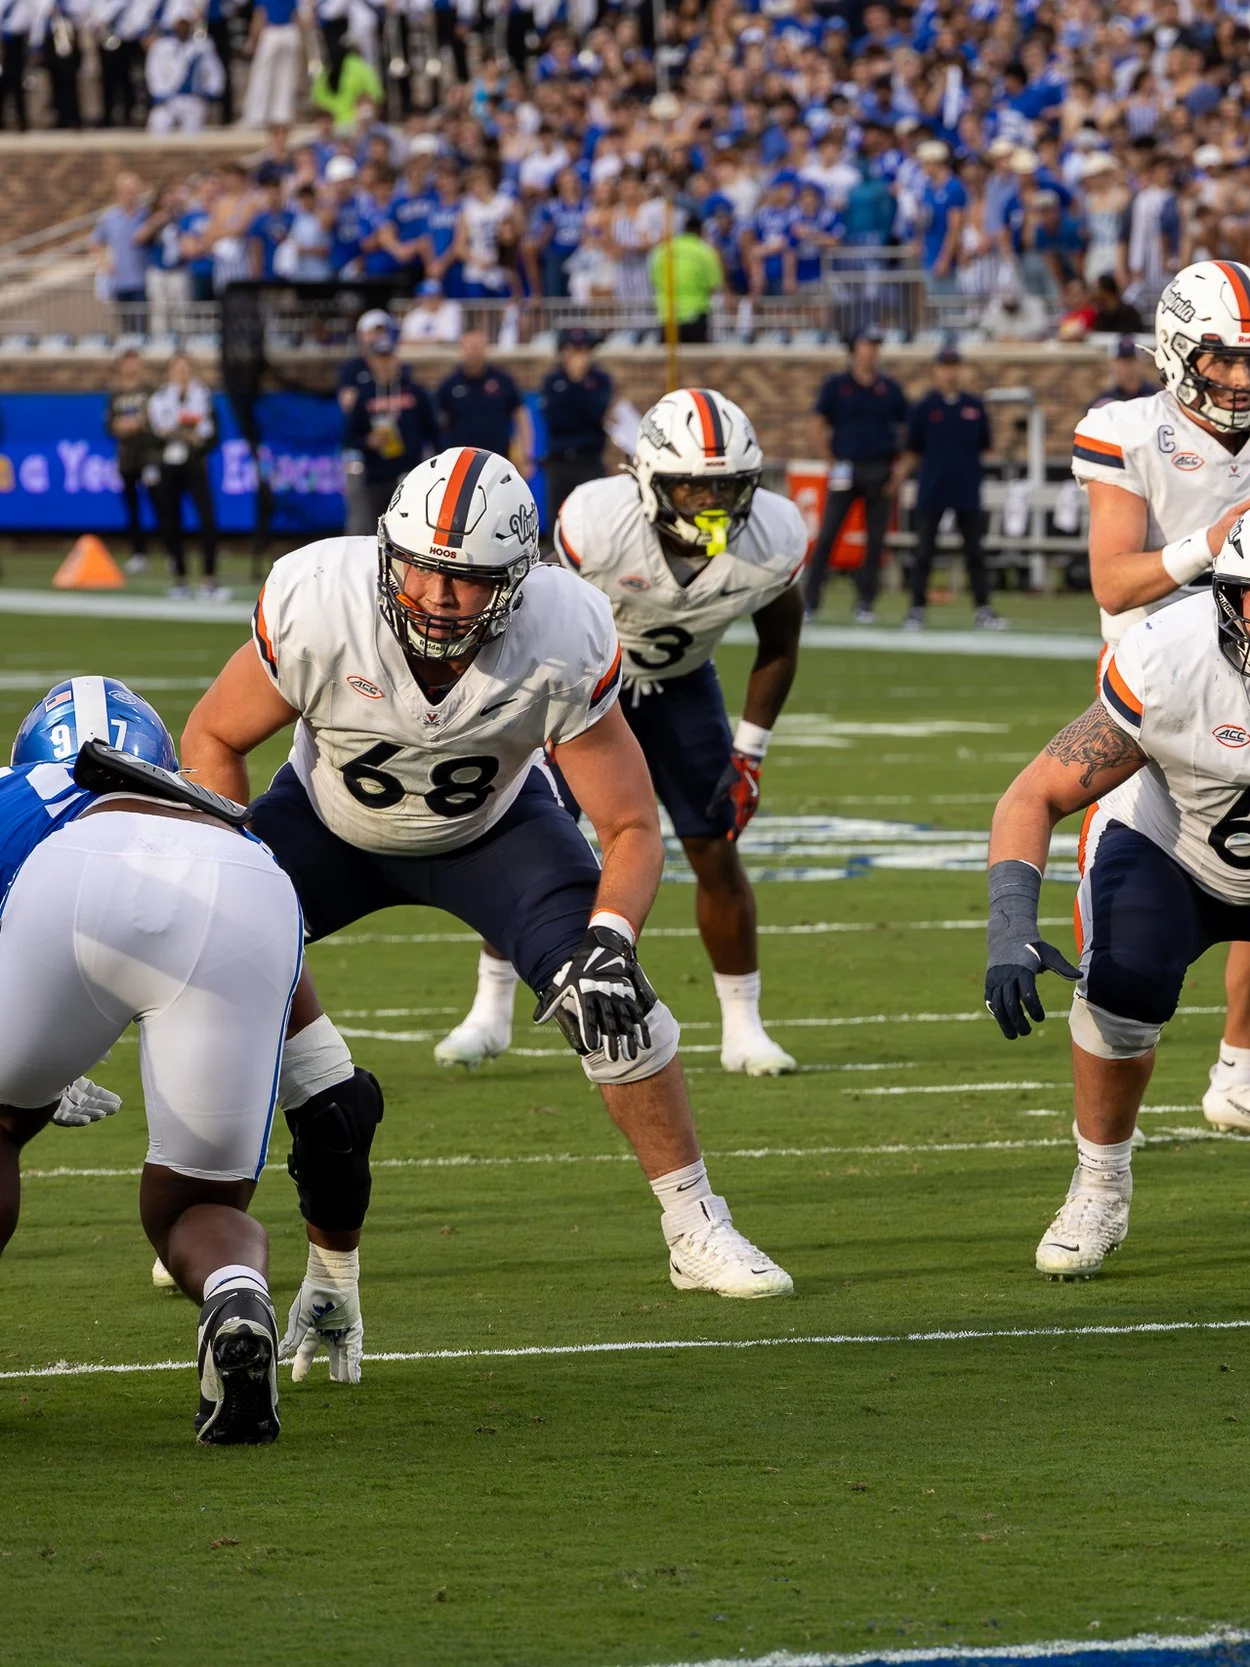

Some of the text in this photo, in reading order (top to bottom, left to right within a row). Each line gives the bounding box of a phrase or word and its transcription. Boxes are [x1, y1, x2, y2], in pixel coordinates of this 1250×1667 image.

[1158, 425, 1175, 453] C
[509, 502, 538, 545] Virg
[429, 546, 457, 559] HOOS
[419, 639, 447, 652] Rddell
[627, 626, 694, 670] 3
[351, 678, 377, 696] ACC
[50, 724, 72, 758] 9
[1217, 729, 1247, 743] ACC
[339, 739, 500, 818] 68
